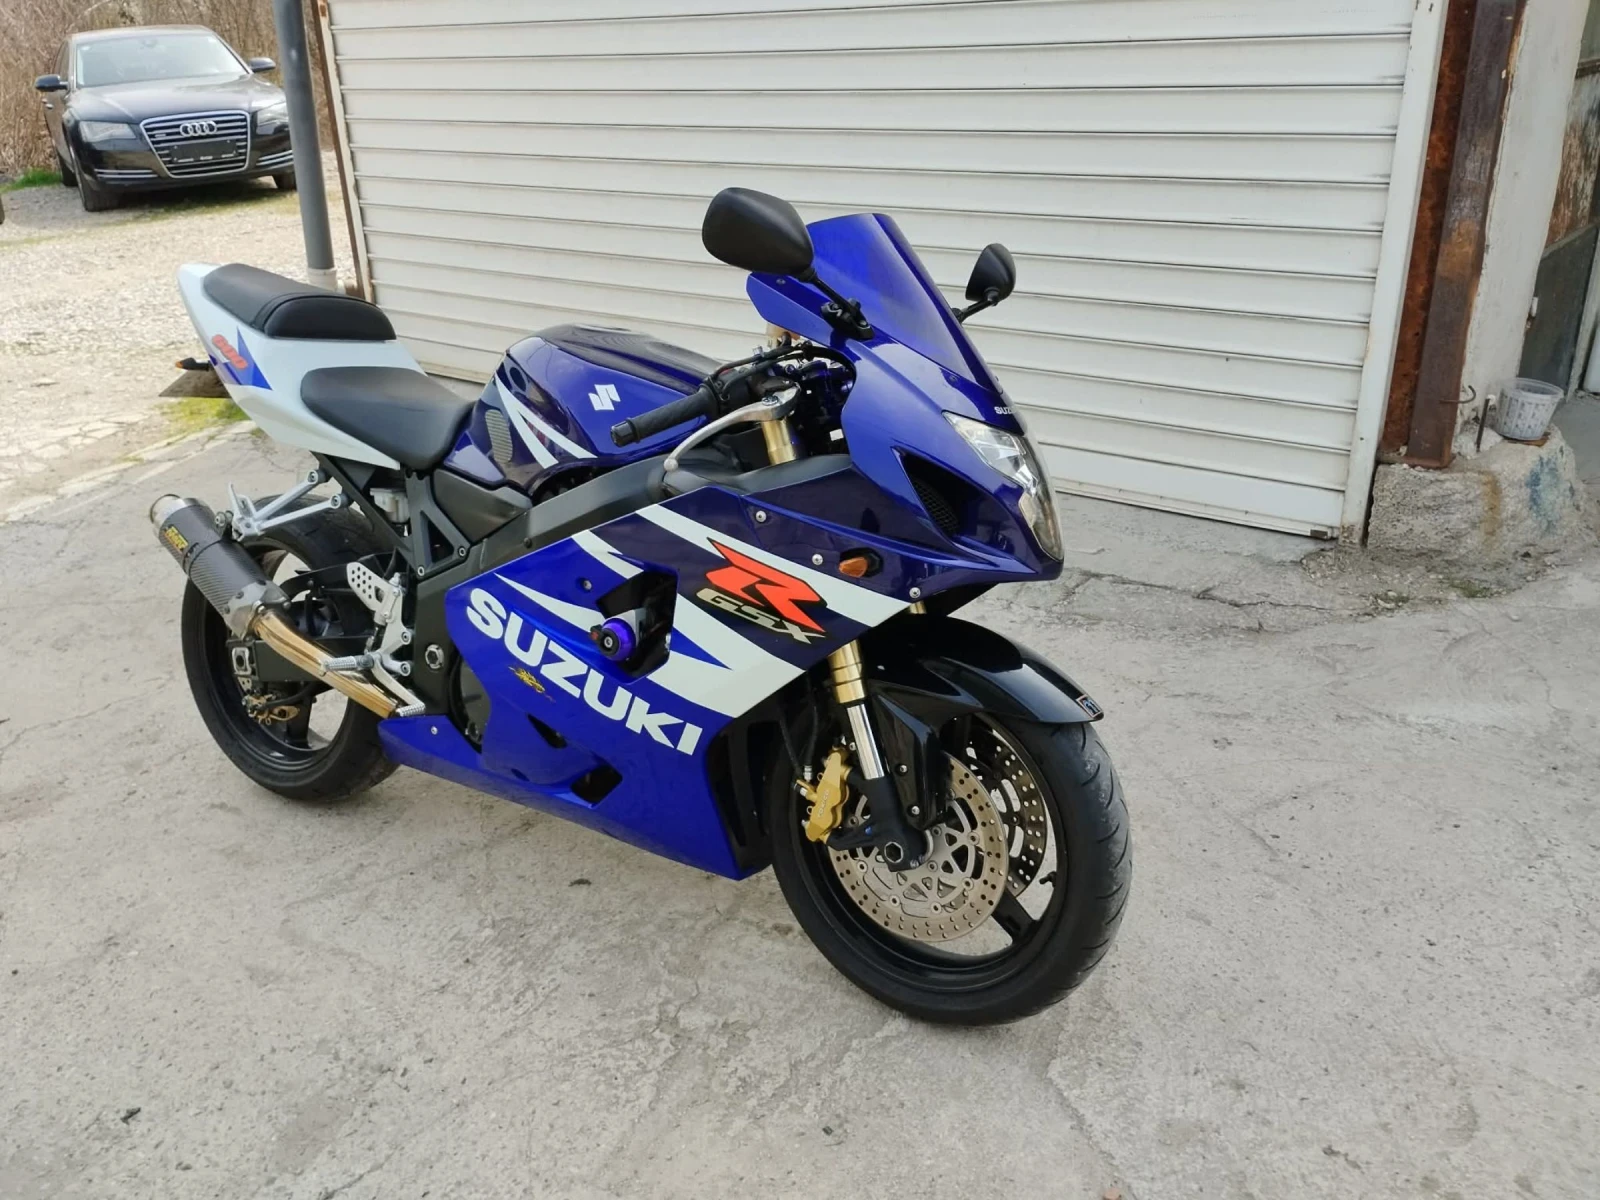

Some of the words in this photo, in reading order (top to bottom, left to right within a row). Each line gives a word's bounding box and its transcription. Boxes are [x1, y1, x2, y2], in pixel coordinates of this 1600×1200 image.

[696, 588, 826, 644] GSX
[706, 537, 826, 633] R
[466, 588, 703, 756] SUZUKI
